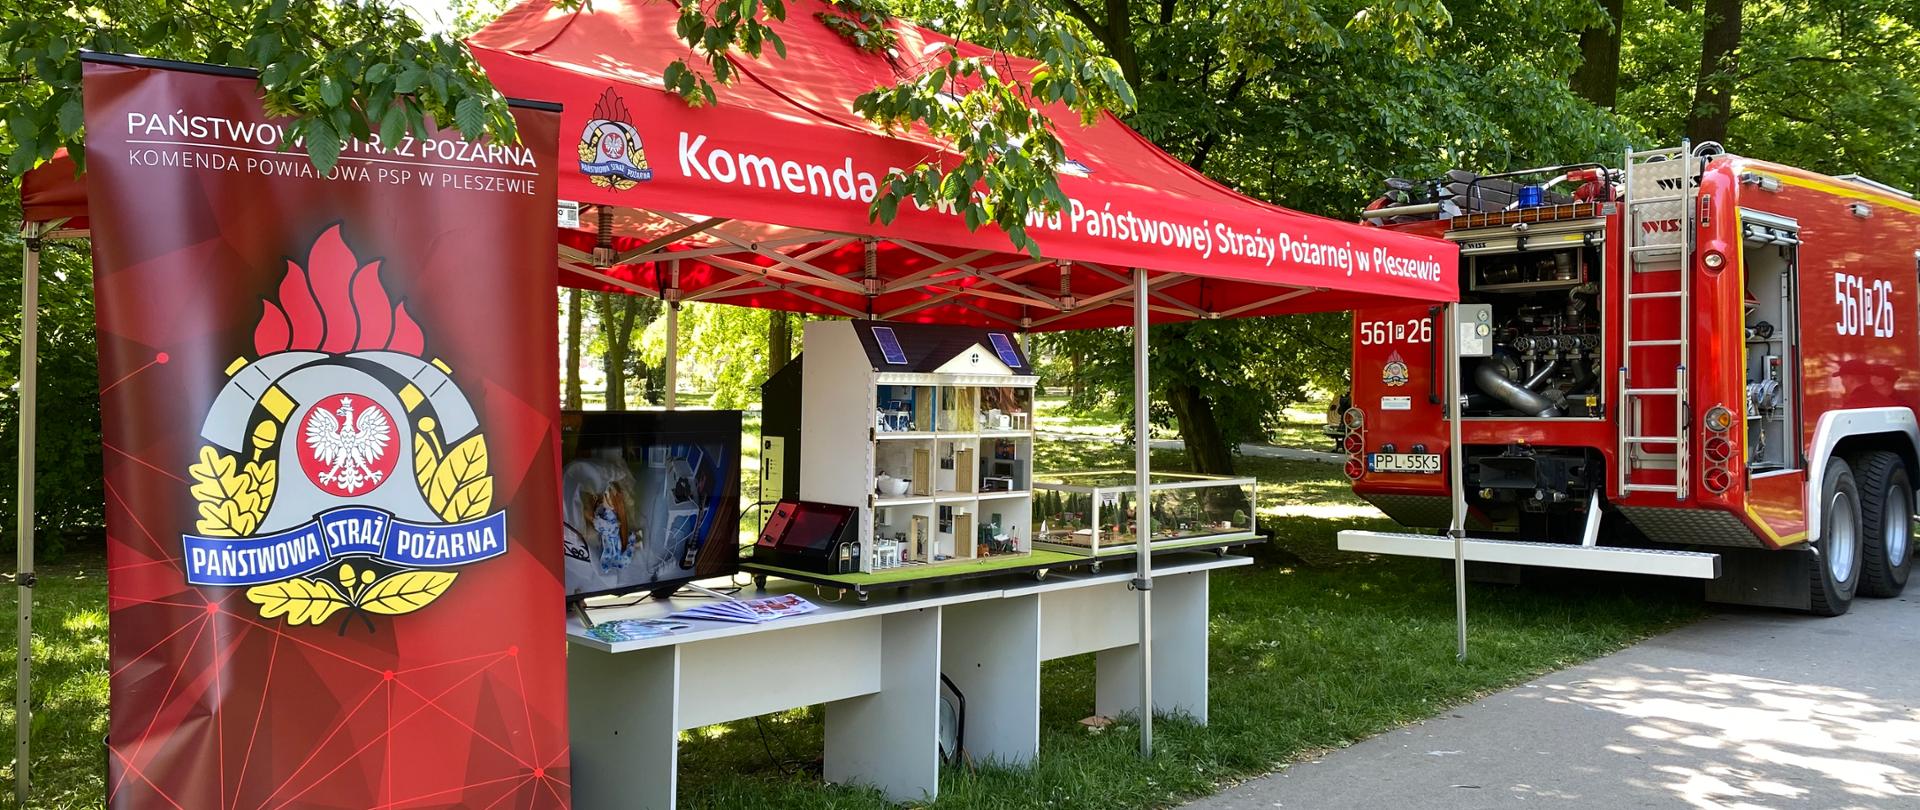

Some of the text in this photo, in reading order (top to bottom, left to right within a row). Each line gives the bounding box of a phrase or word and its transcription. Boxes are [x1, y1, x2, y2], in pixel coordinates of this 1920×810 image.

[127, 109, 304, 148] PAŃSTWOW
[422, 136, 537, 168] POŻARNA
[129, 150, 240, 172] KOMENDA
[378, 168, 411, 185] PSP
[418, 171, 435, 187] W
[442, 173, 536, 195] PLESZEWIE
[678, 131, 878, 203] Komenda
[1069, 198, 1212, 259] Państwowej
[1215, 222, 1275, 267] Straży
[1279, 232, 1353, 277] Pożarnej
[1355, 250, 1370, 272] w
[1373, 247, 1441, 282] Pleszewie
[1641, 218, 1682, 234] WIS
[1376, 455, 1439, 469] PPL 55K5
[192, 515, 498, 577] PAŃSTWOWA STRAŻ POŻARNA
